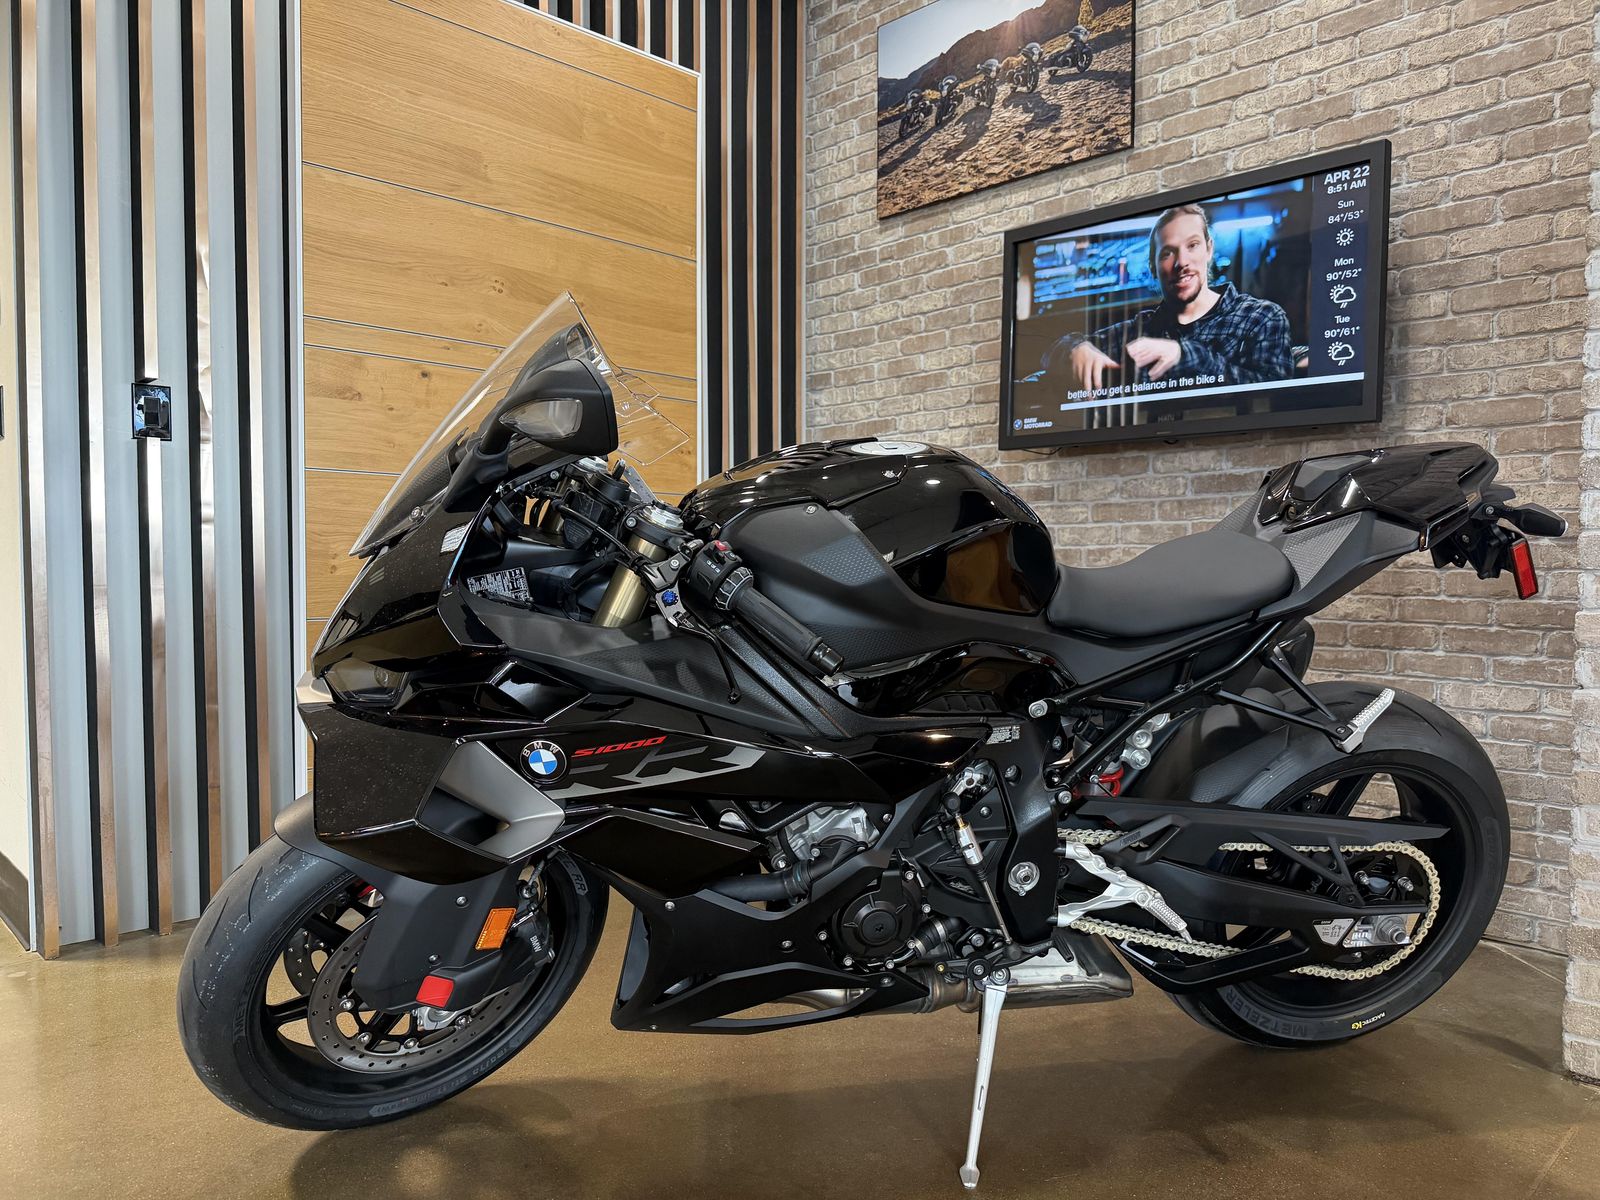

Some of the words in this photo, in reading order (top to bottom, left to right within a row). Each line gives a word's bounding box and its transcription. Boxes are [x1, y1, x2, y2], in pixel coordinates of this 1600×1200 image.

[1323, 170, 1350, 185] APR
[1353, 165, 1370, 178] 22
[1327, 183, 1348, 194] 8:51
[1350, 179, 1367, 189] AM
[1337, 200, 1355, 209] Sun
[1334, 257, 1354, 267] Mon
[1334, 315, 1351, 324] Tue
[1067, 390, 1090, 400] better
[1092, 388, 1107, 399] you
[1109, 385, 1123, 397] get
[1124, 385, 1130, 393] a
[1132, 380, 1166, 392] balance
[1168, 378, 1177, 388] in
[1179, 377, 1194, 387] the
[1196, 374, 1216, 385] bike
[1217, 374, 1224, 382] a
[522, 741, 560, 758] BMW
[570, 735, 668, 758] S1000
[530, 935, 542, 952] BMW
[1225, 987, 1308, 1038] METZELER
